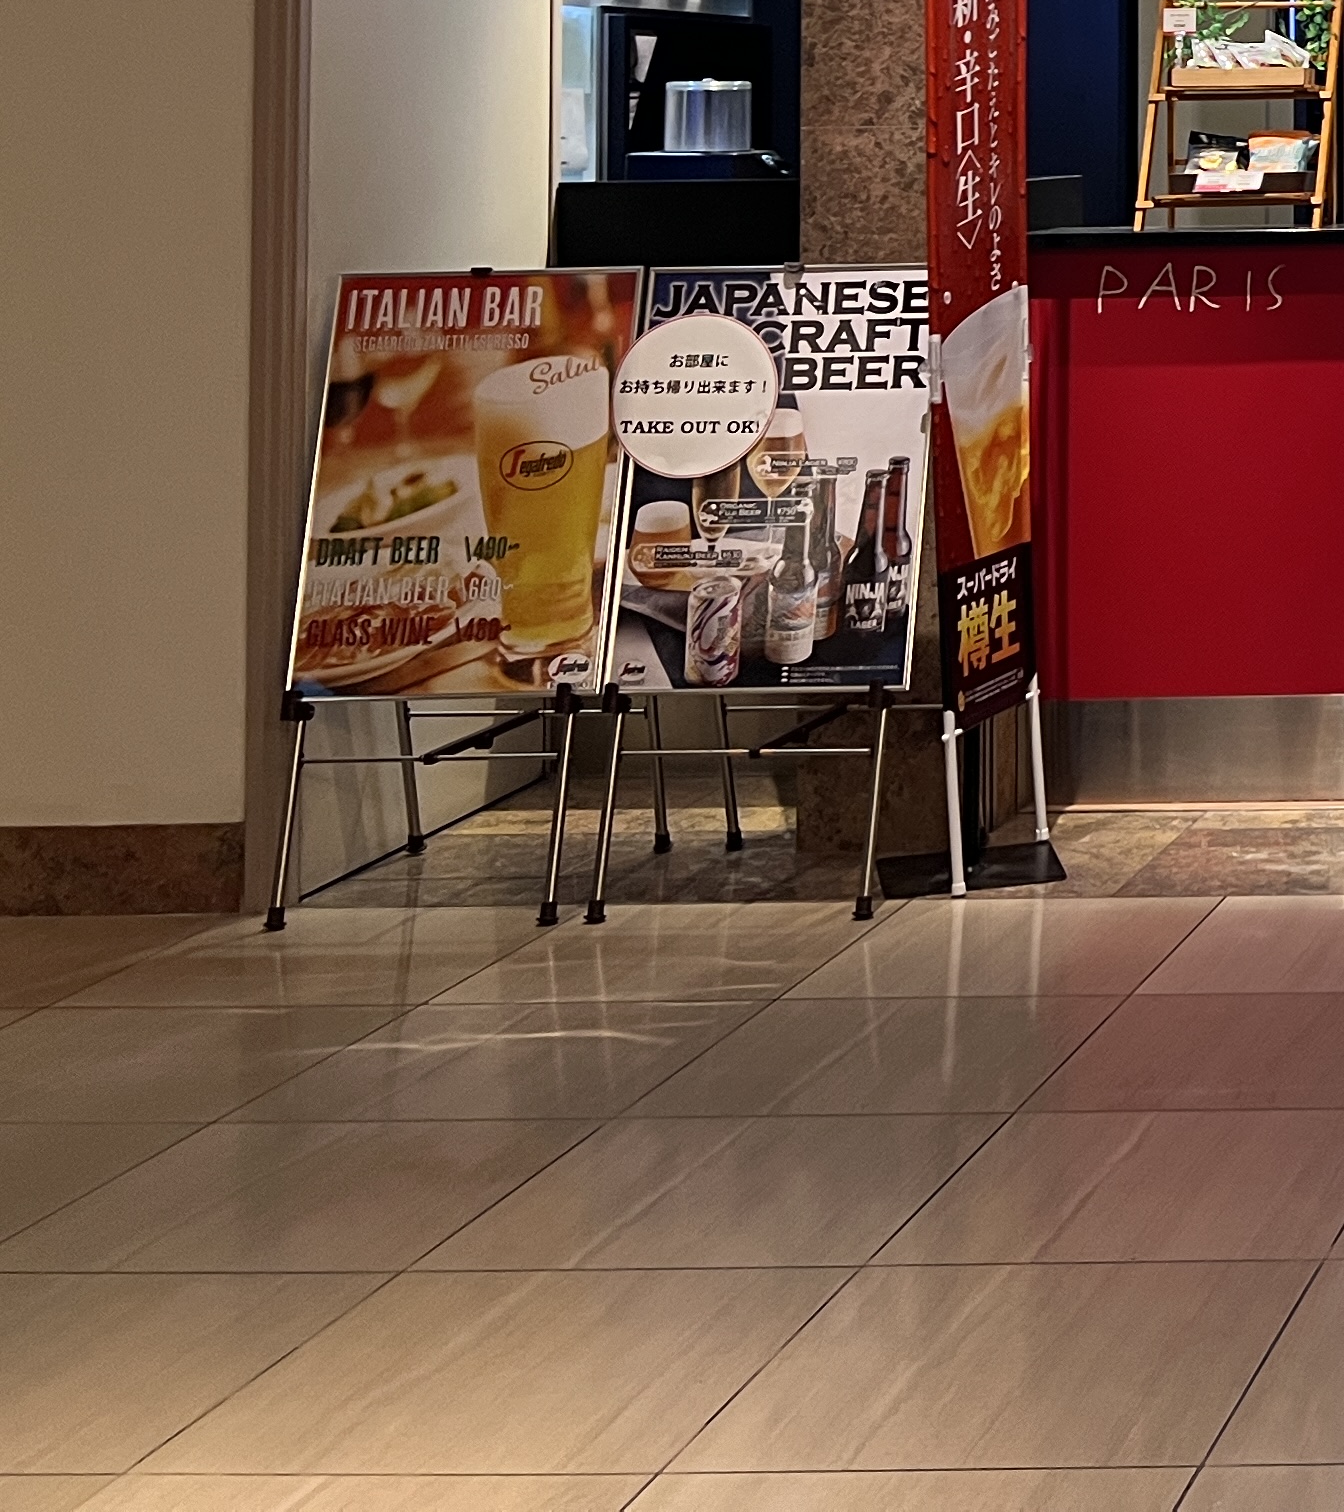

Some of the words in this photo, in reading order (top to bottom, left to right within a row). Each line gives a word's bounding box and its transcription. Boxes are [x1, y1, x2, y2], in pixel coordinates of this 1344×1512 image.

[653, 280, 929, 318] JAPANESE
[1097, 262, 1288, 314] PARIS
[346, 287, 471, 331] ITALIAN
[481, 286, 544, 328] BAR
[753, 318, 929, 355] CRAFT
[669, 354, 729, 369] お部屋に
[781, 355, 927, 392] BEER
[620, 379, 768, 395] お持ち帰り出来ます！
[620, 420, 674, 435] TAKE
[681, 420, 721, 435] OUT
[727, 420, 760, 434] OK!
[315, 537, 384, 567] DRAFT
[390, 536, 440, 564] BEER
[311, 577, 393, 607] ITALIAN
[400, 576, 451, 605] BEER
[957, 556, 1017, 600] スーパードライ
[305, 618, 372, 648] GLASS
[382, 617, 435, 645] WINE
[957, 590, 1021, 678] 樽生
